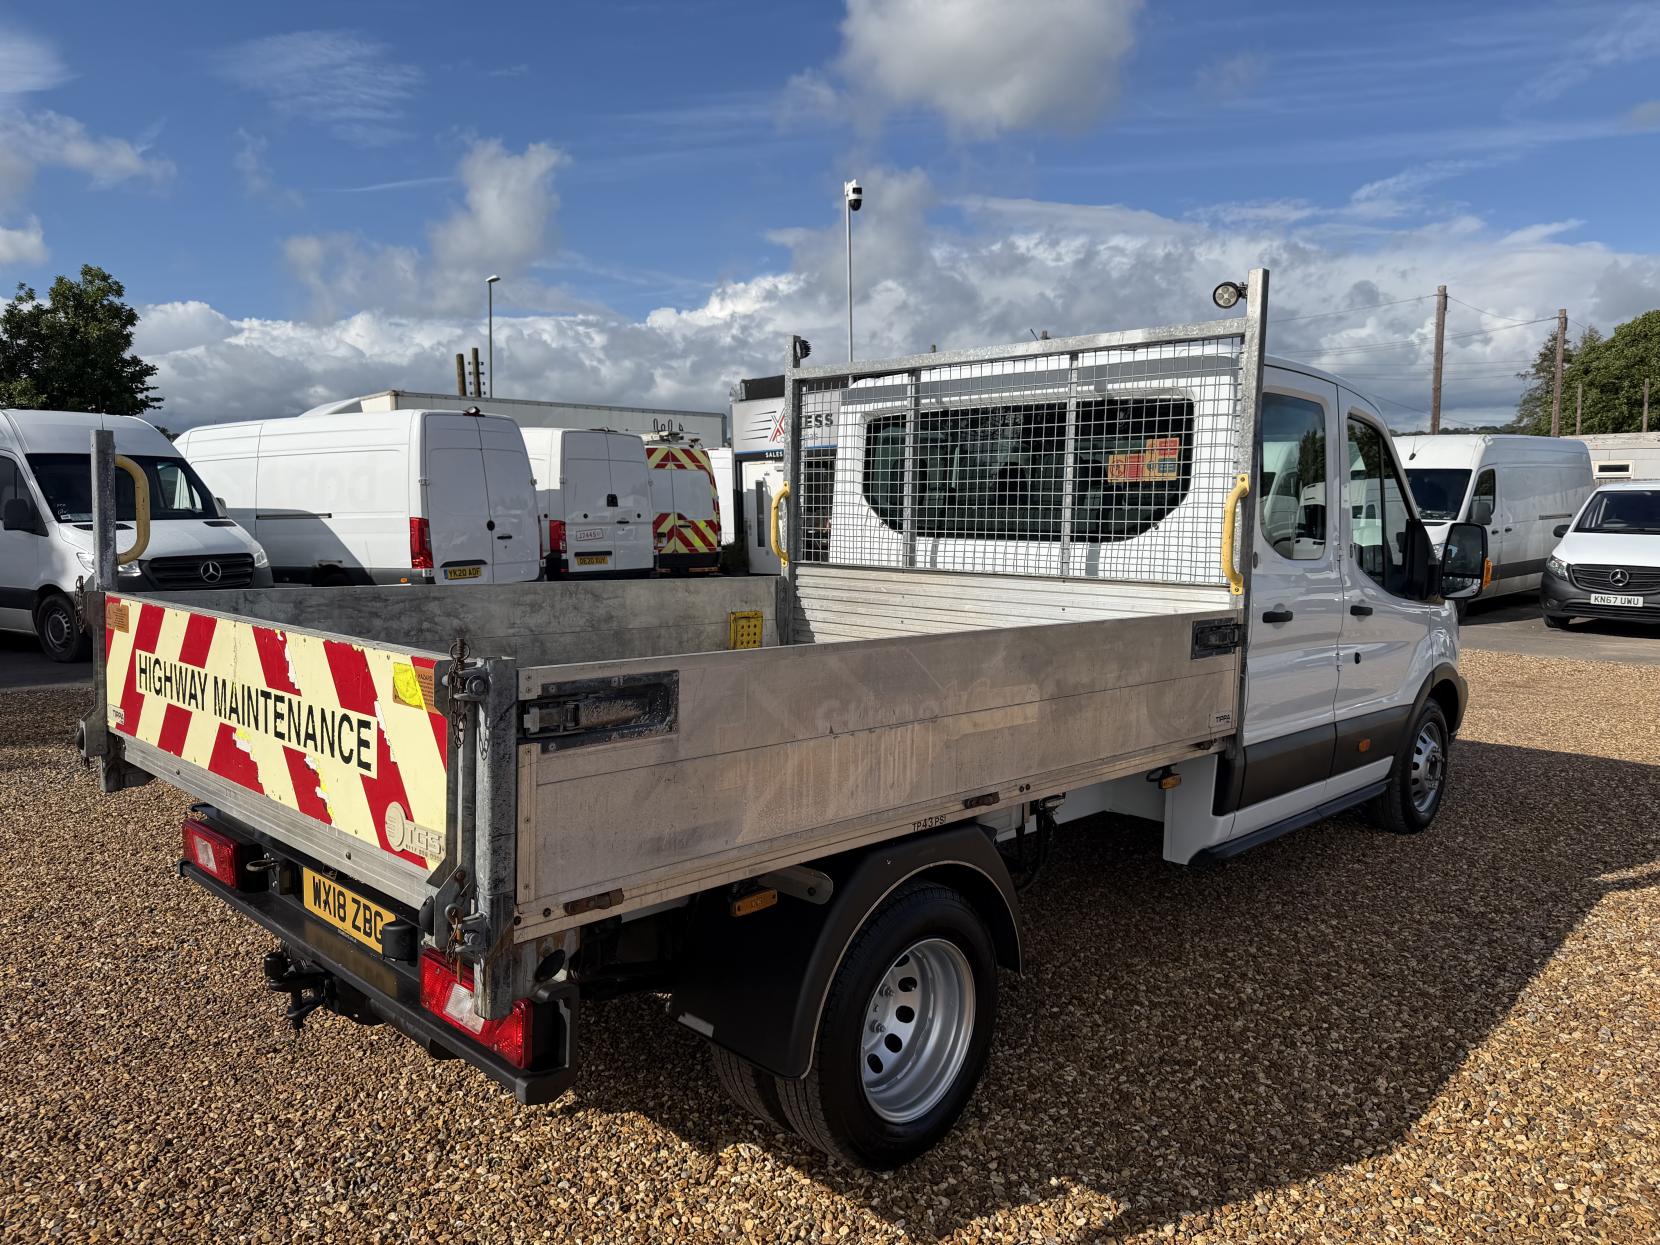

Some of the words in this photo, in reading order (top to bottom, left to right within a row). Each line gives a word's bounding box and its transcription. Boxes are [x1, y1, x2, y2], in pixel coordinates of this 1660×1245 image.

[765, 451, 783, 459] SALES
[1594, 595, 1618, 604] KN67
[1620, 597, 1639, 605] UWU
[139, 653, 208, 711] HIGHWAY
[213, 675, 373, 772] MAINTENANCE
[312, 875, 347, 923] WX18
